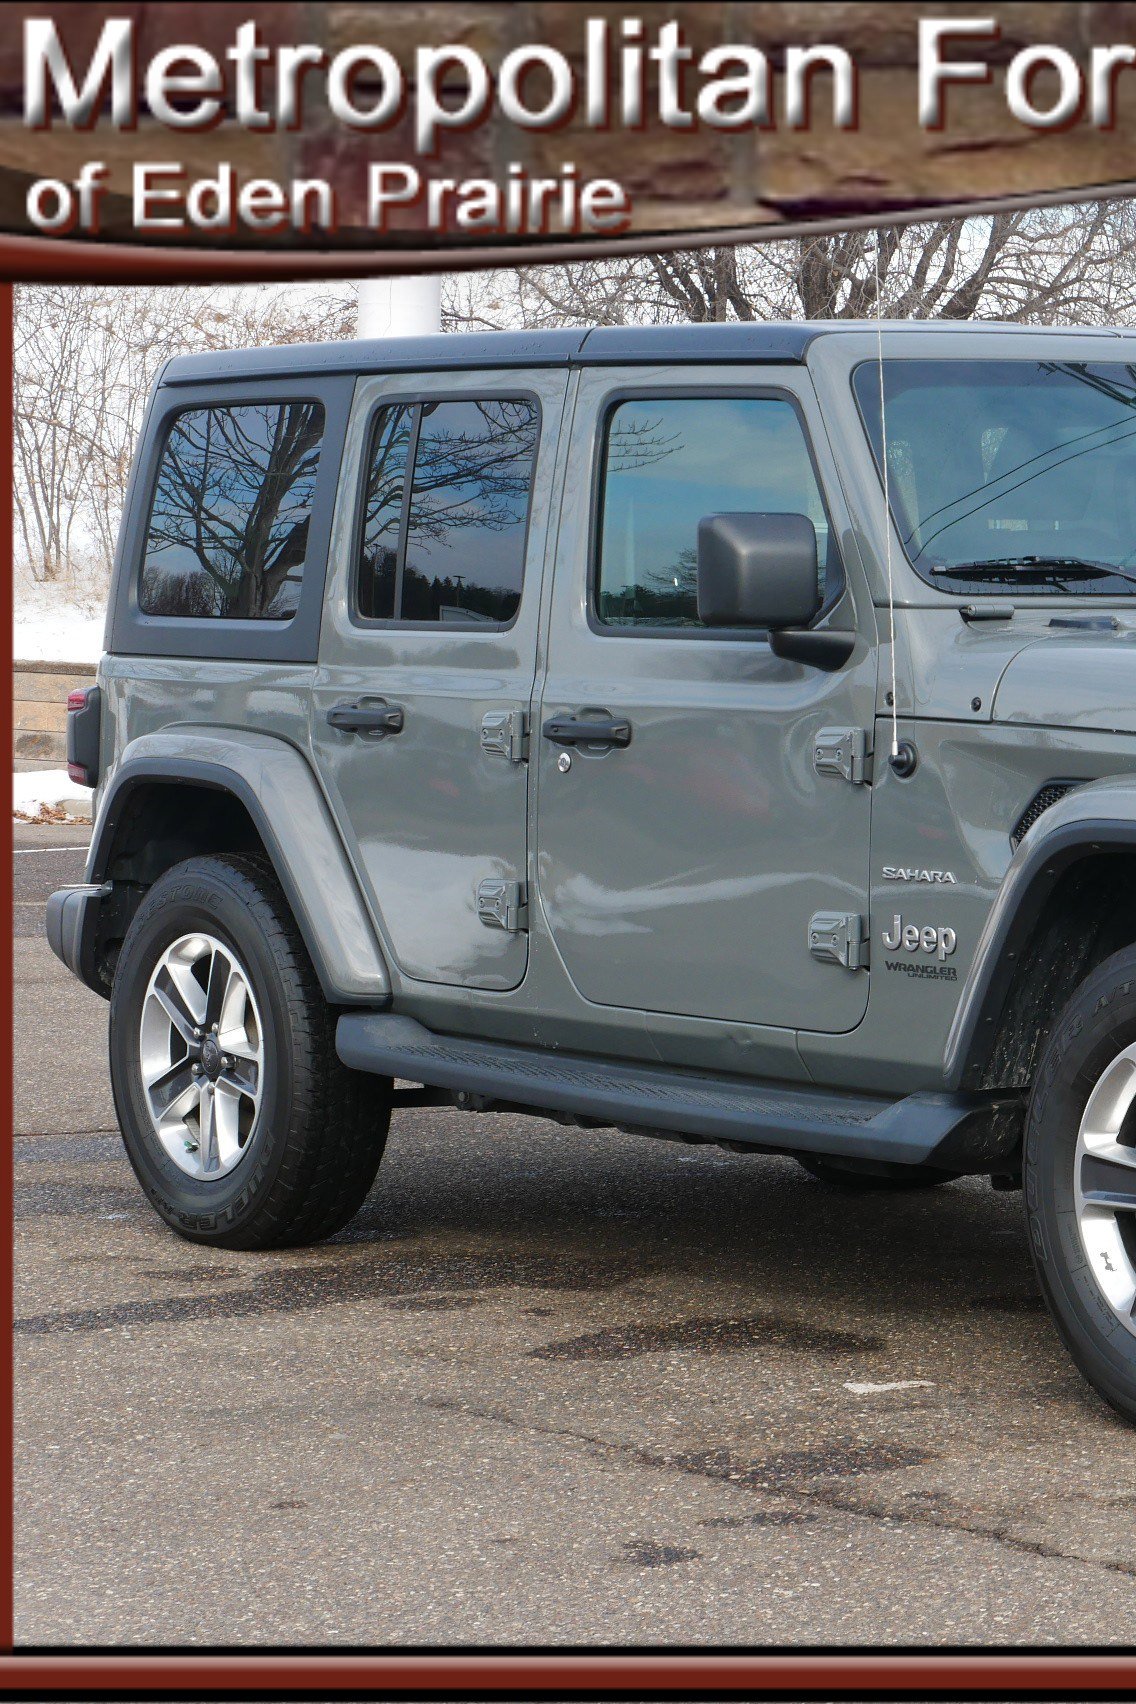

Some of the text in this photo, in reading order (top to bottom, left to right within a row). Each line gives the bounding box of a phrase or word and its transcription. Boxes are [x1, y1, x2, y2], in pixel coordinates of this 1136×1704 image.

[881, 866, 957, 884] SAHARA
[882, 914, 957, 961] Jeep
[885, 960, 958, 976] WRANGLER
[907, 971, 958, 981] UNLIMITED
